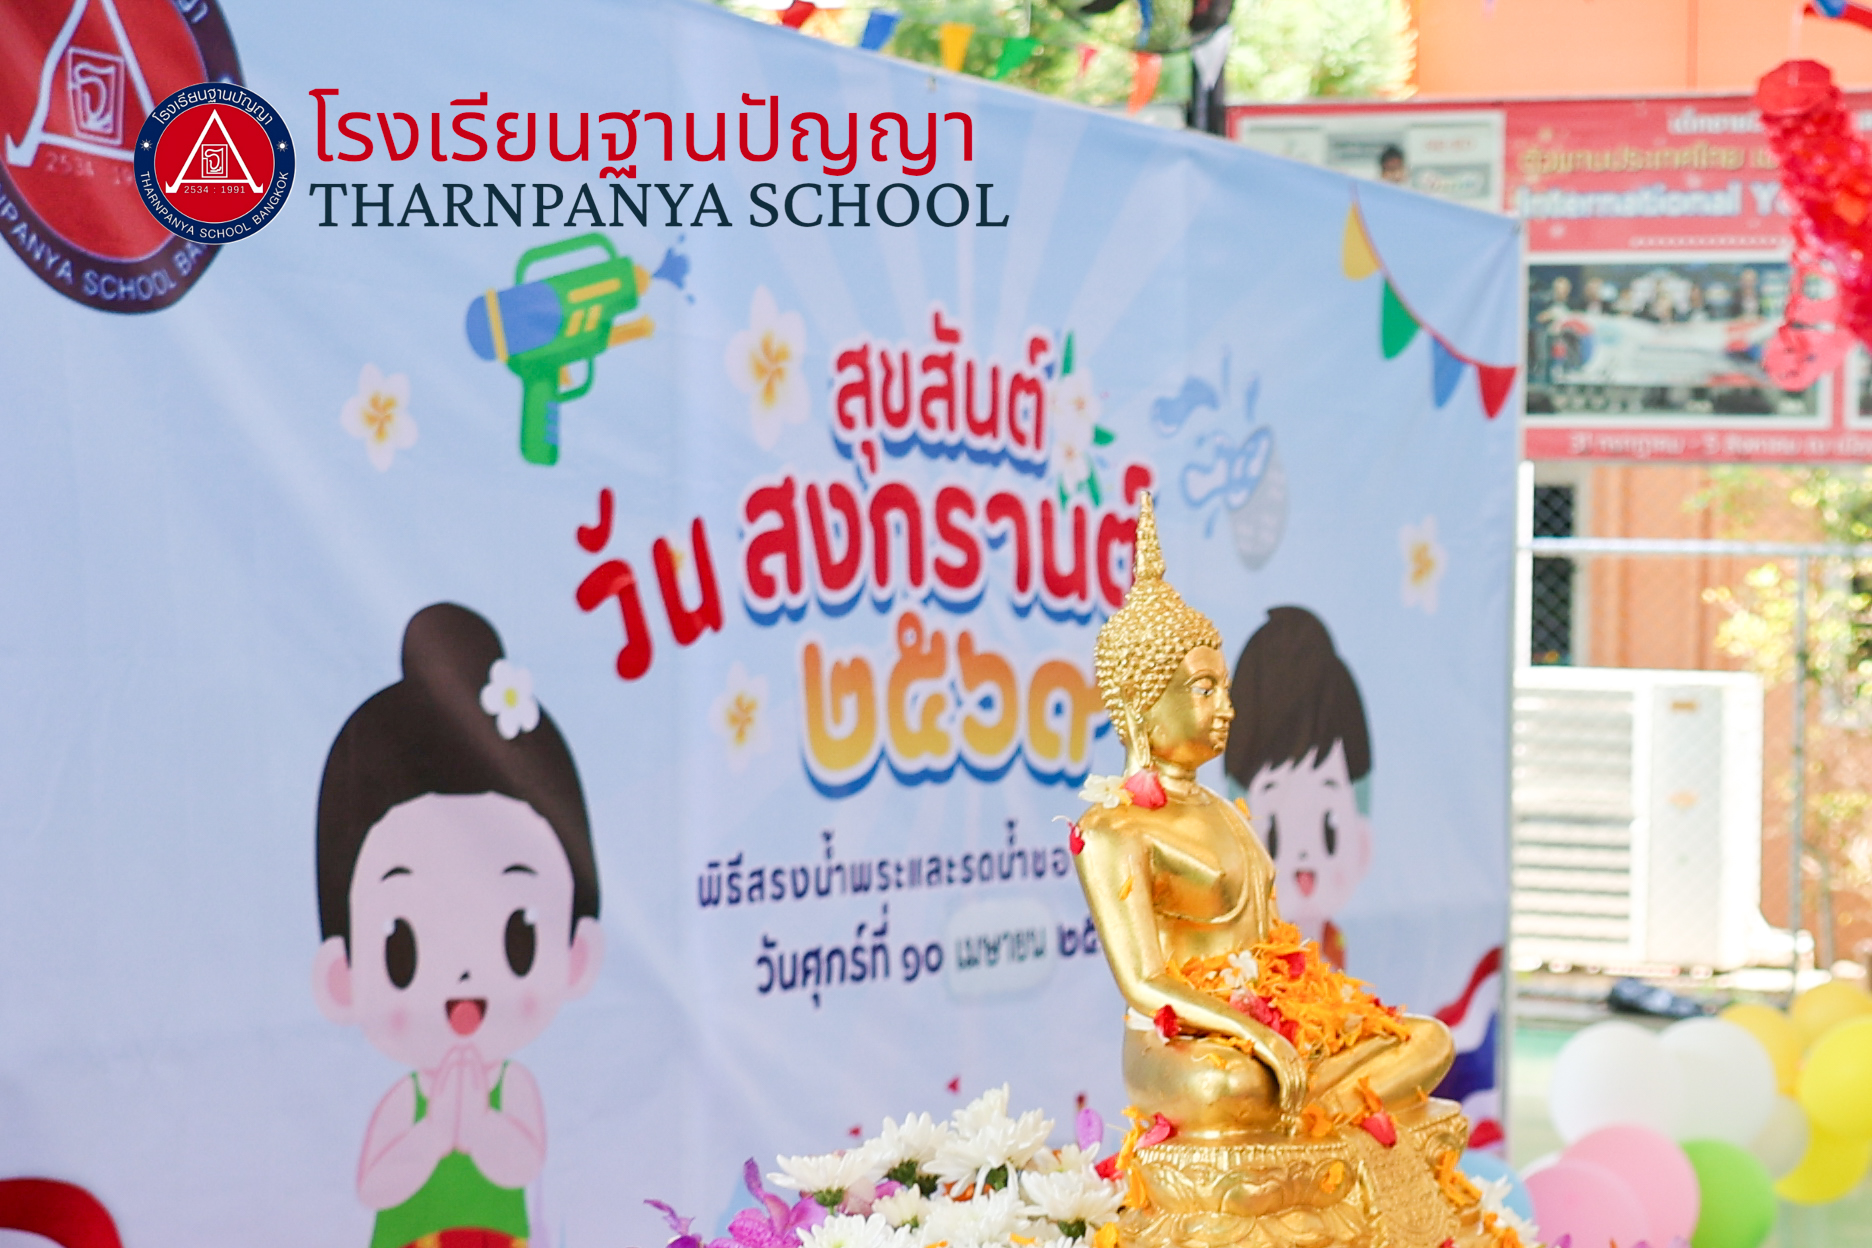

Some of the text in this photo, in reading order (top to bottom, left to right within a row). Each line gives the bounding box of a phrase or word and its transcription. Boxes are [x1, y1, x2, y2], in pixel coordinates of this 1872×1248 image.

[0, 197, 177, 301] PANYA SCHOOL
[1517, 180, 1742, 219] International
[833, 311, 1050, 474] สุขสันต์
[576, 464, 1153, 681] วัน สงกรานต์
[698, 819, 1073, 909] พิธีสรงน้ำพระและรดน้ำขอ
[756, 901, 891, 1009] วันศุกร์ที่
[902, 940, 944, 983] ๑๐
[1057, 917, 1097, 957] ๒๕
